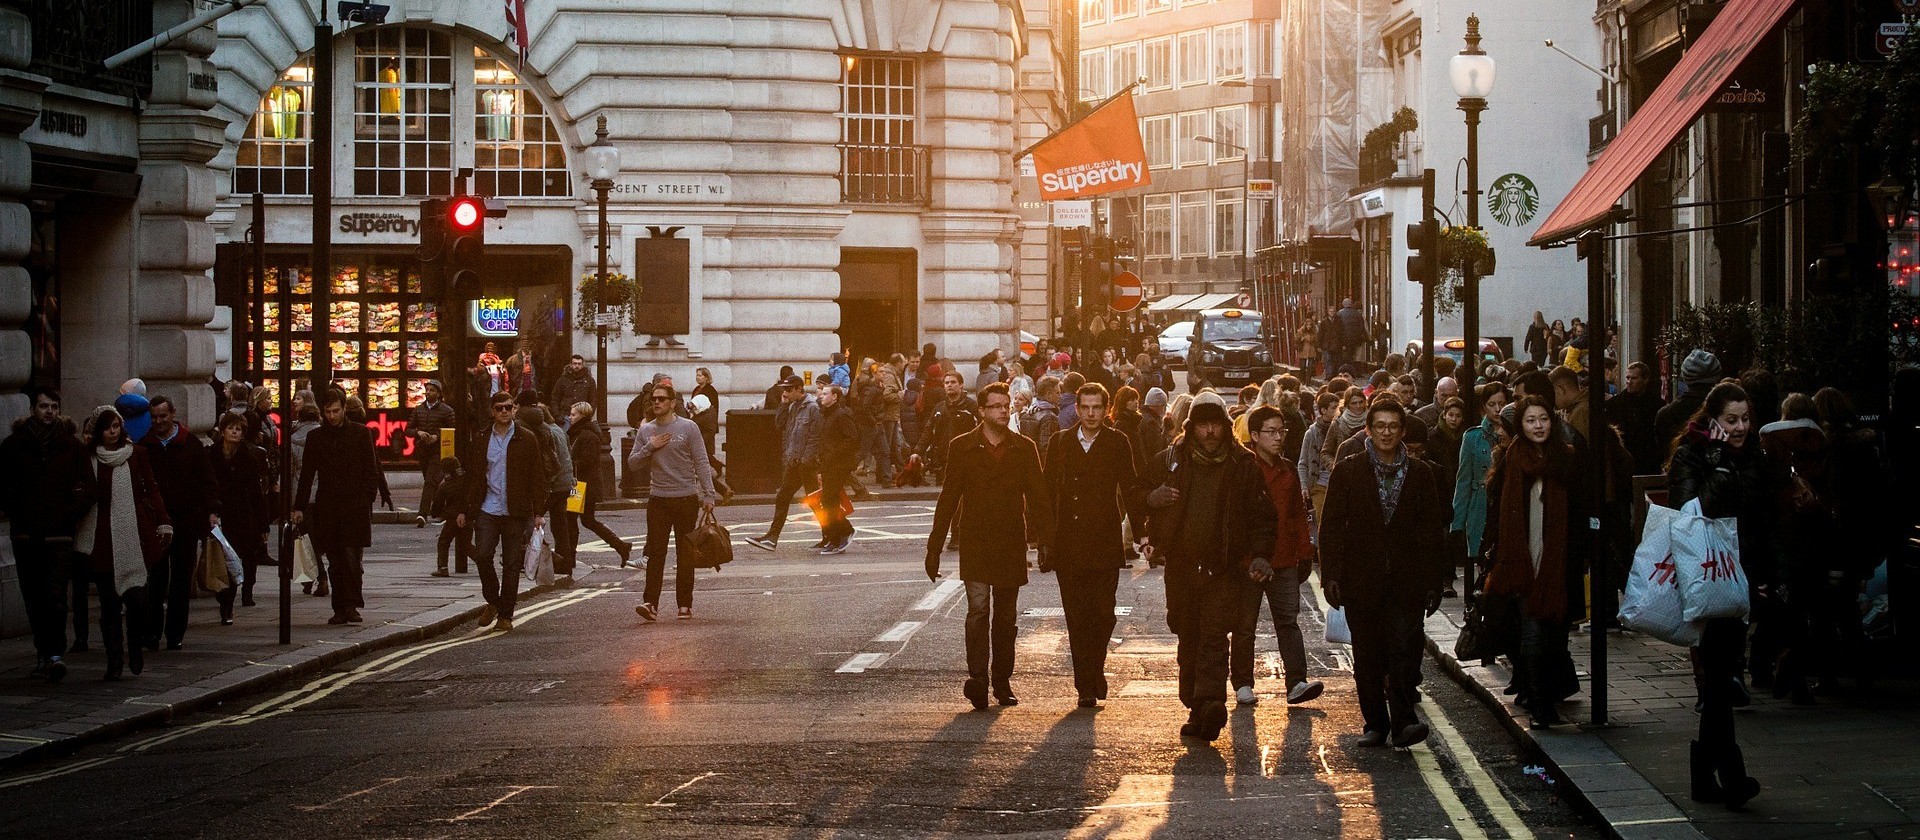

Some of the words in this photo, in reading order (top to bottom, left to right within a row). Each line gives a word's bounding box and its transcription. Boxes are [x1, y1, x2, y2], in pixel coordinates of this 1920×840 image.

[1042, 160, 1143, 193] Superdry
[658, 184, 701, 193] STREET
[340, 214, 421, 237] Superdry
